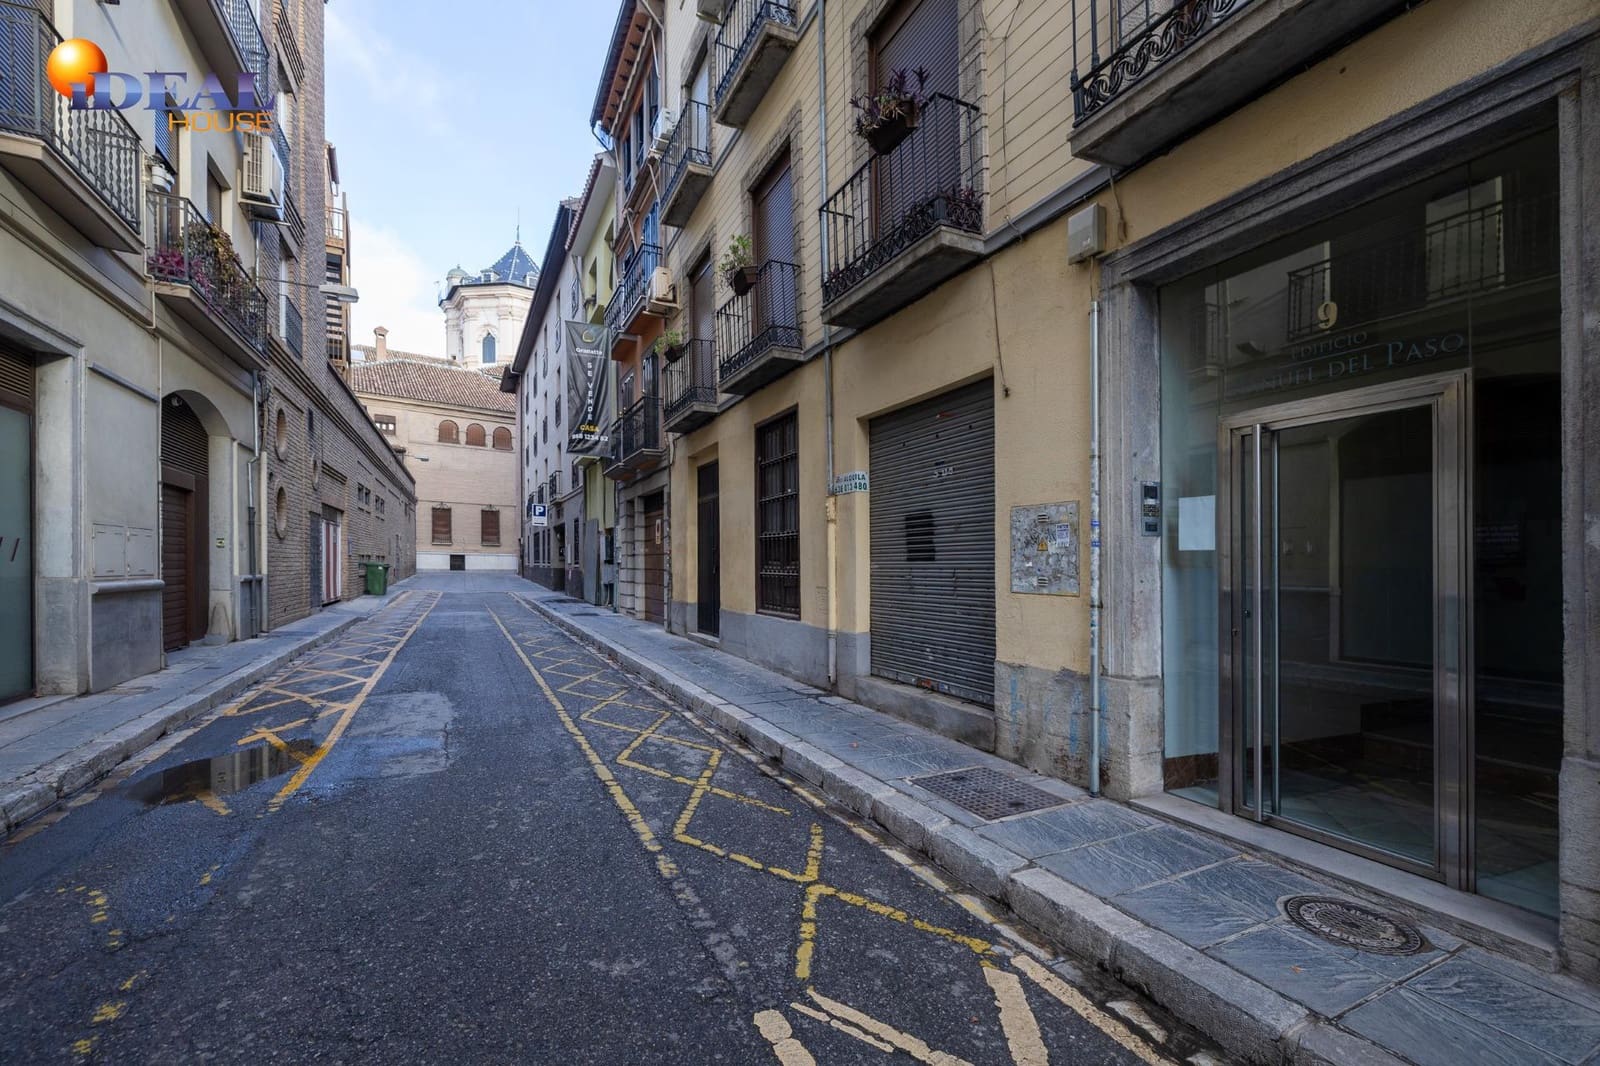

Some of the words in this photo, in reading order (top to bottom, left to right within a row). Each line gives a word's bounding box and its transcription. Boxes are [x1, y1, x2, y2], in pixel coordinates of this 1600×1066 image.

[1318, 301, 1338, 329] 9
[1329, 354, 1374, 378] DEL
[854, 482, 867, 491] 480
[535, 505, 544, 516] P
